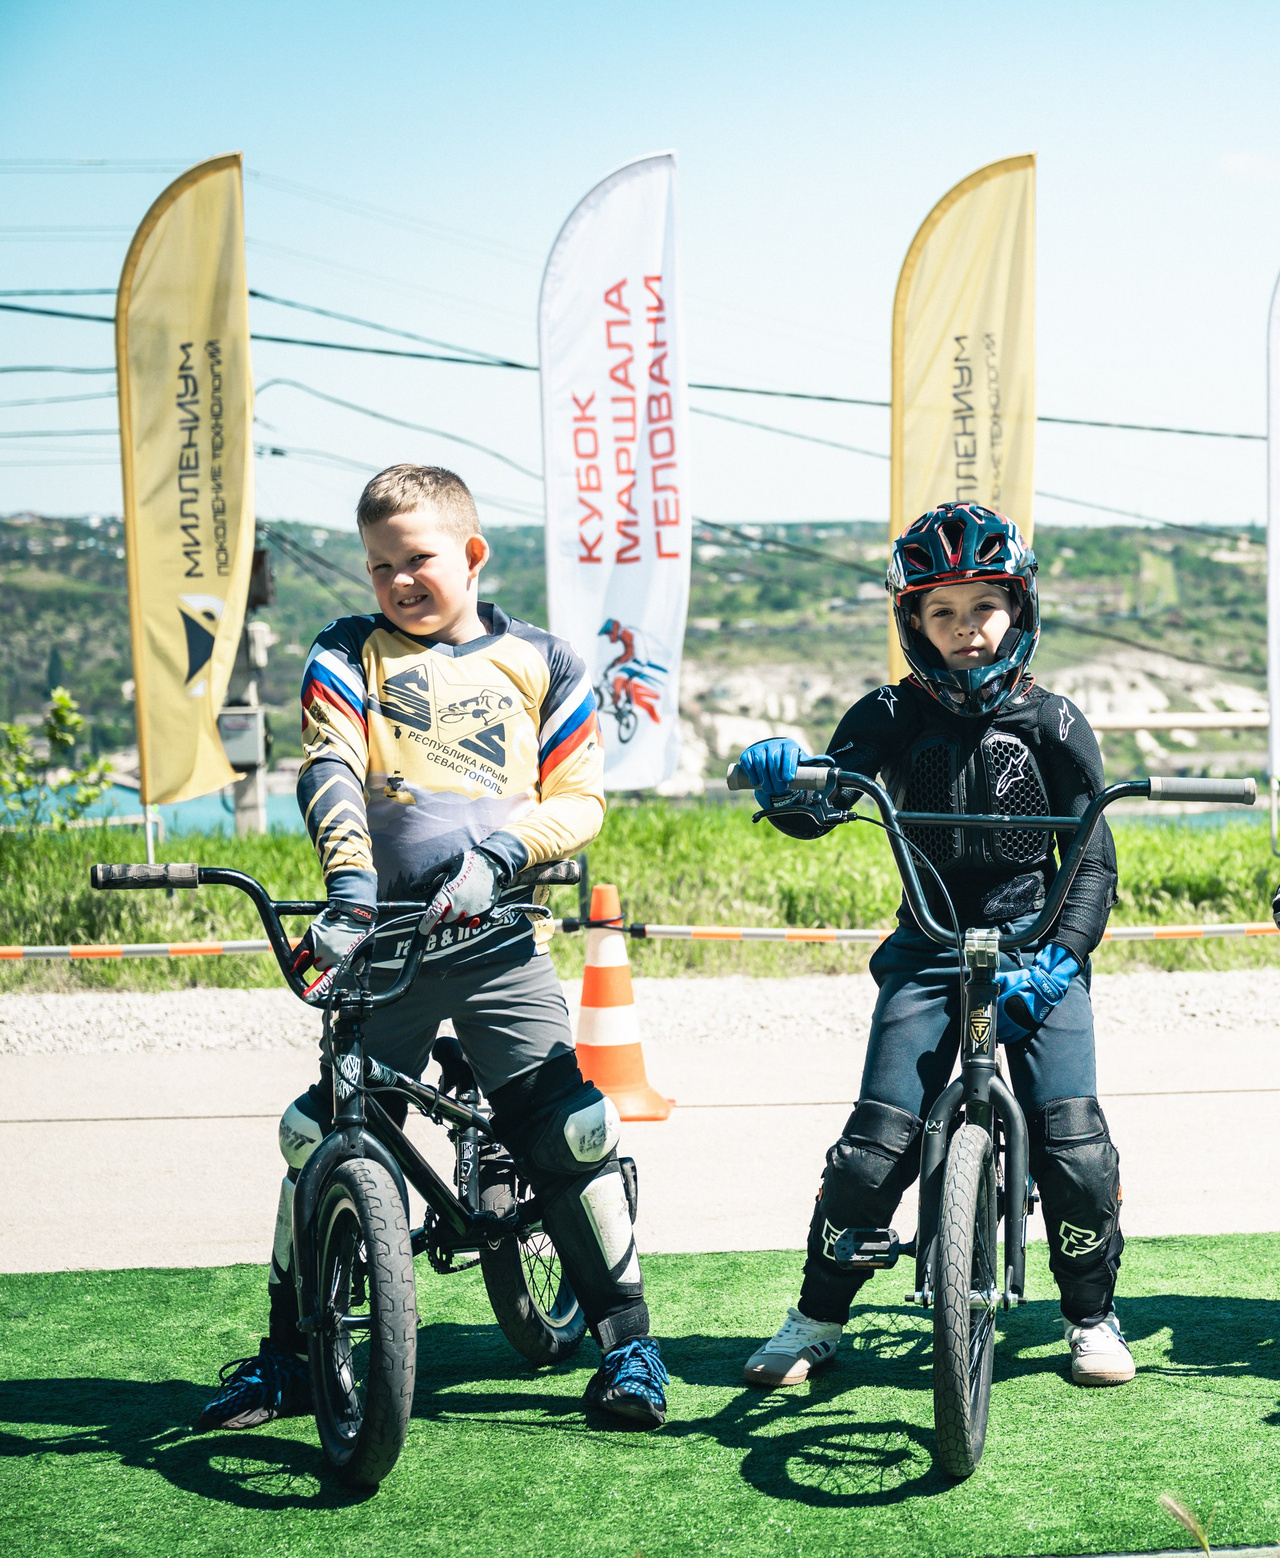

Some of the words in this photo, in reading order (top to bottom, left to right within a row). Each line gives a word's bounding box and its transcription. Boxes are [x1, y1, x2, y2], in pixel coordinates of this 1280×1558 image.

[175, 341, 204, 579] МИЛЛЕНИУМ
[204, 339, 224, 460] ТЕХНОЛОГИЙ
[604, 277, 641, 565] МАРШАЛА
[643, 275, 680, 560] ГЕЛОВАНИ
[952, 335, 979, 505] ЛЛЕНИУМ
[210, 465, 229, 577] ПОКОЛЕНИЕ
[571, 391, 603, 565] КУБОК
[407, 730, 478, 769] РЕСПУБЛИКА
[478, 762, 509, 785] КРЫМ
[426, 752, 504, 796] СЕВАСТОПОЛЬ
[394, 934, 437, 958] rae
